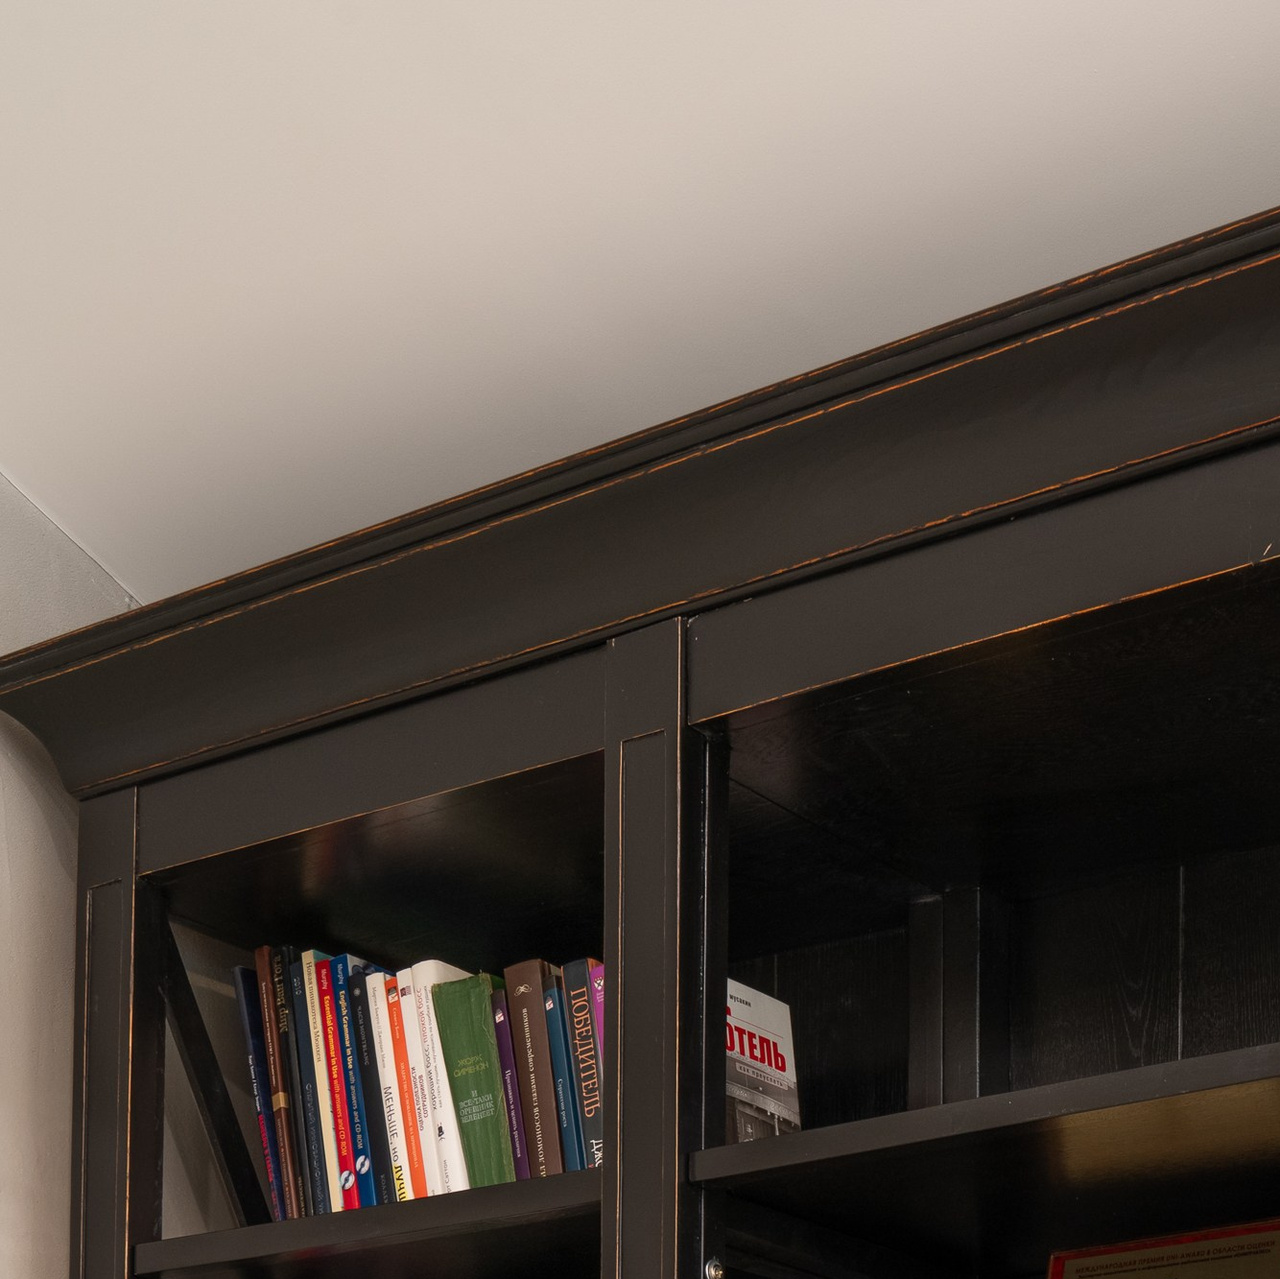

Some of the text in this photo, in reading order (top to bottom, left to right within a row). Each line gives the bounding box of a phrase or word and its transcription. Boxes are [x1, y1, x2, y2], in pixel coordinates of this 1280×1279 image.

[320, 969, 328, 989] Murphy
[335, 964, 344, 984] Murphy
[323, 995, 333, 1026] Essential
[338, 990, 347, 1015] English
[343, 1017, 351, 1047] Grammar
[327, 1027, 336, 1058] Grammar
[571, 987, 599, 1117] ПОБЕДИТЕЛЬ
[331, 1065, 339, 1078] Use
[519, 1007, 545, 1163] ЛОМОНОСОВ глазами современников
[334, 1092, 343, 1117] answers
[411, 1067, 425, 1130] ОЦЕНКА ПОЛЕЗНОСТИ
[418, 1073, 429, 1118] СОТРУДНИКОВ
[383, 1086, 397, 1145] МЕНЬШЕ,
[339, 1131, 347, 1156] CD-ROM
